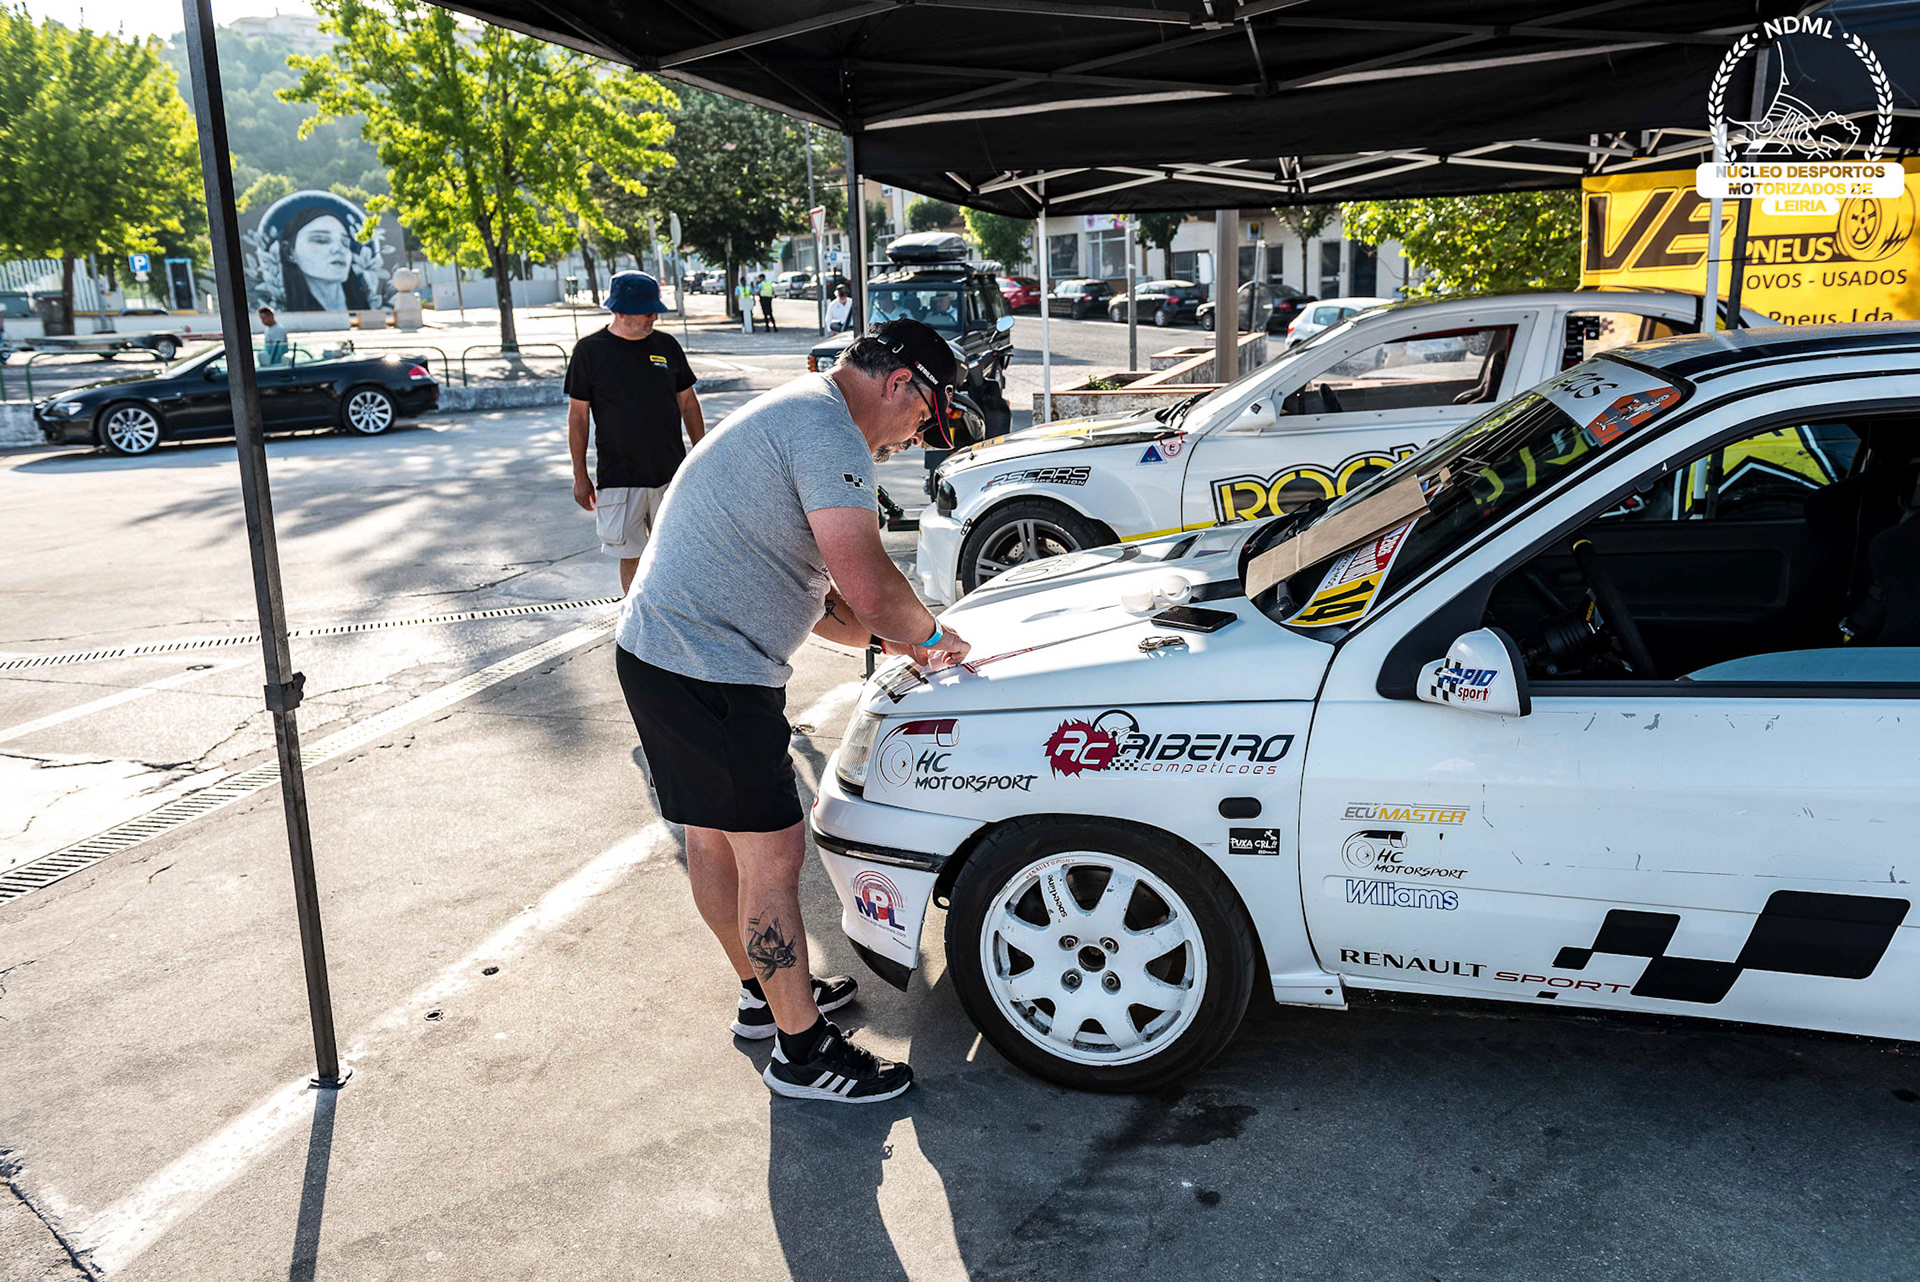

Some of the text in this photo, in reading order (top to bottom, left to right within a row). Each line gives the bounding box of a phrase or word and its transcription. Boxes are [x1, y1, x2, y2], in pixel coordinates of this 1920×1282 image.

[133, 255, 147, 270] P
[1746, 272, 1803, 290] OVOS
[1822, 269, 1908, 287] USADOS
[1295, 579, 1376, 622] 14
[1457, 686, 1489, 702] sport
[1119, 733, 1296, 762] RIBEIRO
[915, 749, 952, 774] HC
[1140, 762, 1278, 775] competicoes
[913, 774, 1039, 793] MOTORSPORT
[1230, 837, 1253, 849] PUXA
[1377, 847, 1404, 864] HC
[1373, 863, 1469, 880] MOTORSPORT
[1339, 948, 1631, 994] RENAULT SPORT
